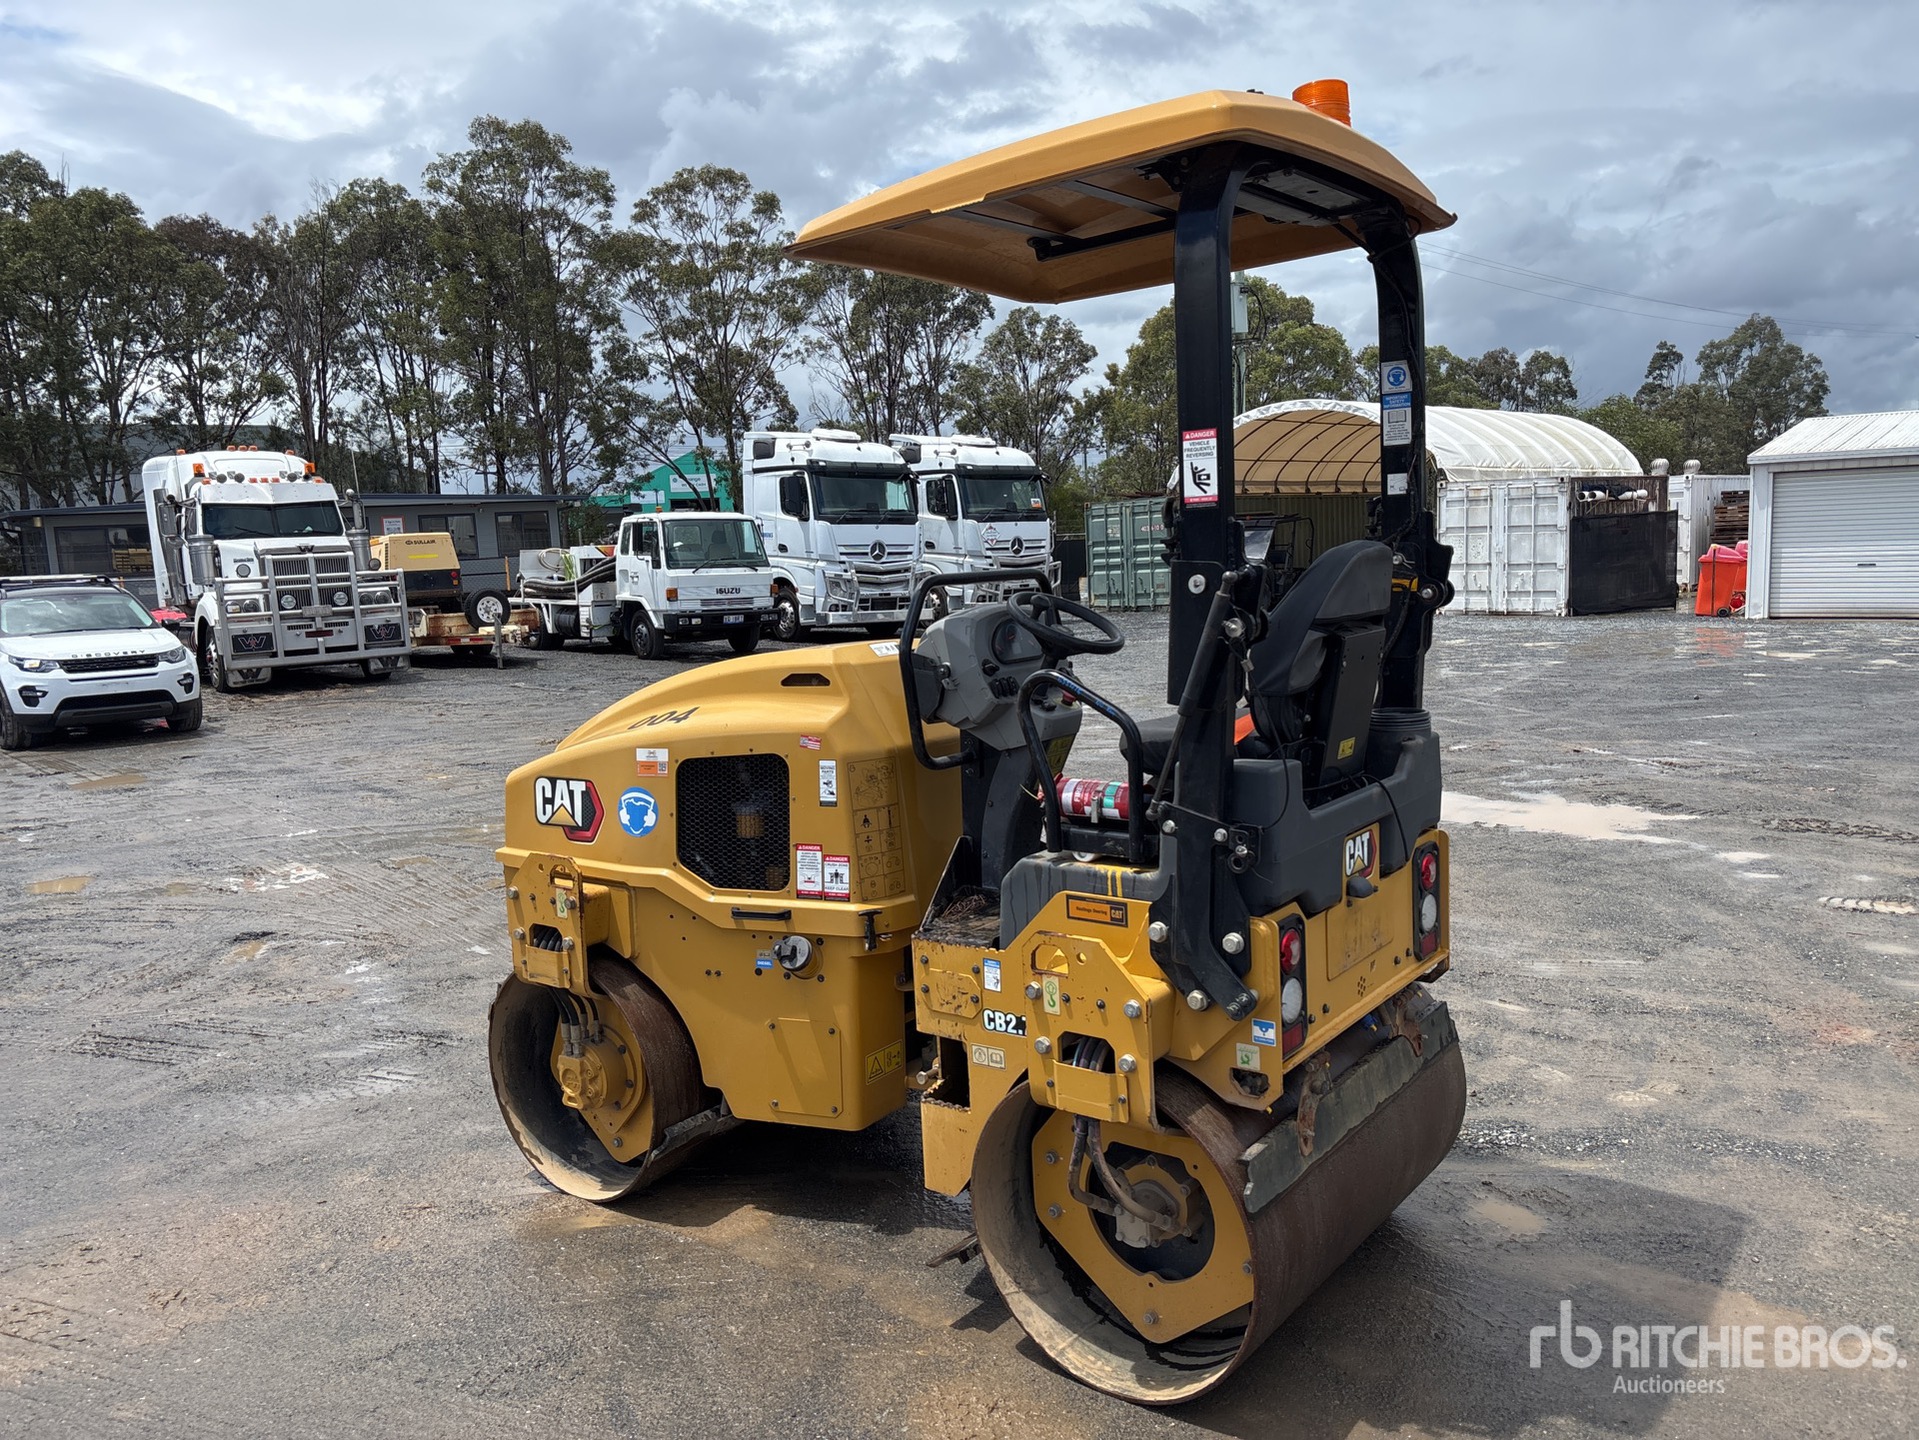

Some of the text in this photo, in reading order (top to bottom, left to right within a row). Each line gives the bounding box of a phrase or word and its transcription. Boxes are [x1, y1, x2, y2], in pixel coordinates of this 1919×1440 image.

[1190, 430, 1214, 439] DANGER
[715, 587, 741, 595] ISUZU
[71, 649, 146, 659] DISCOVERY
[627, 706, 700, 730] 004
[535, 777, 586, 827] CAT
[1345, 831, 1370, 876] CAT
[1111, 909, 1123, 919] CAT
